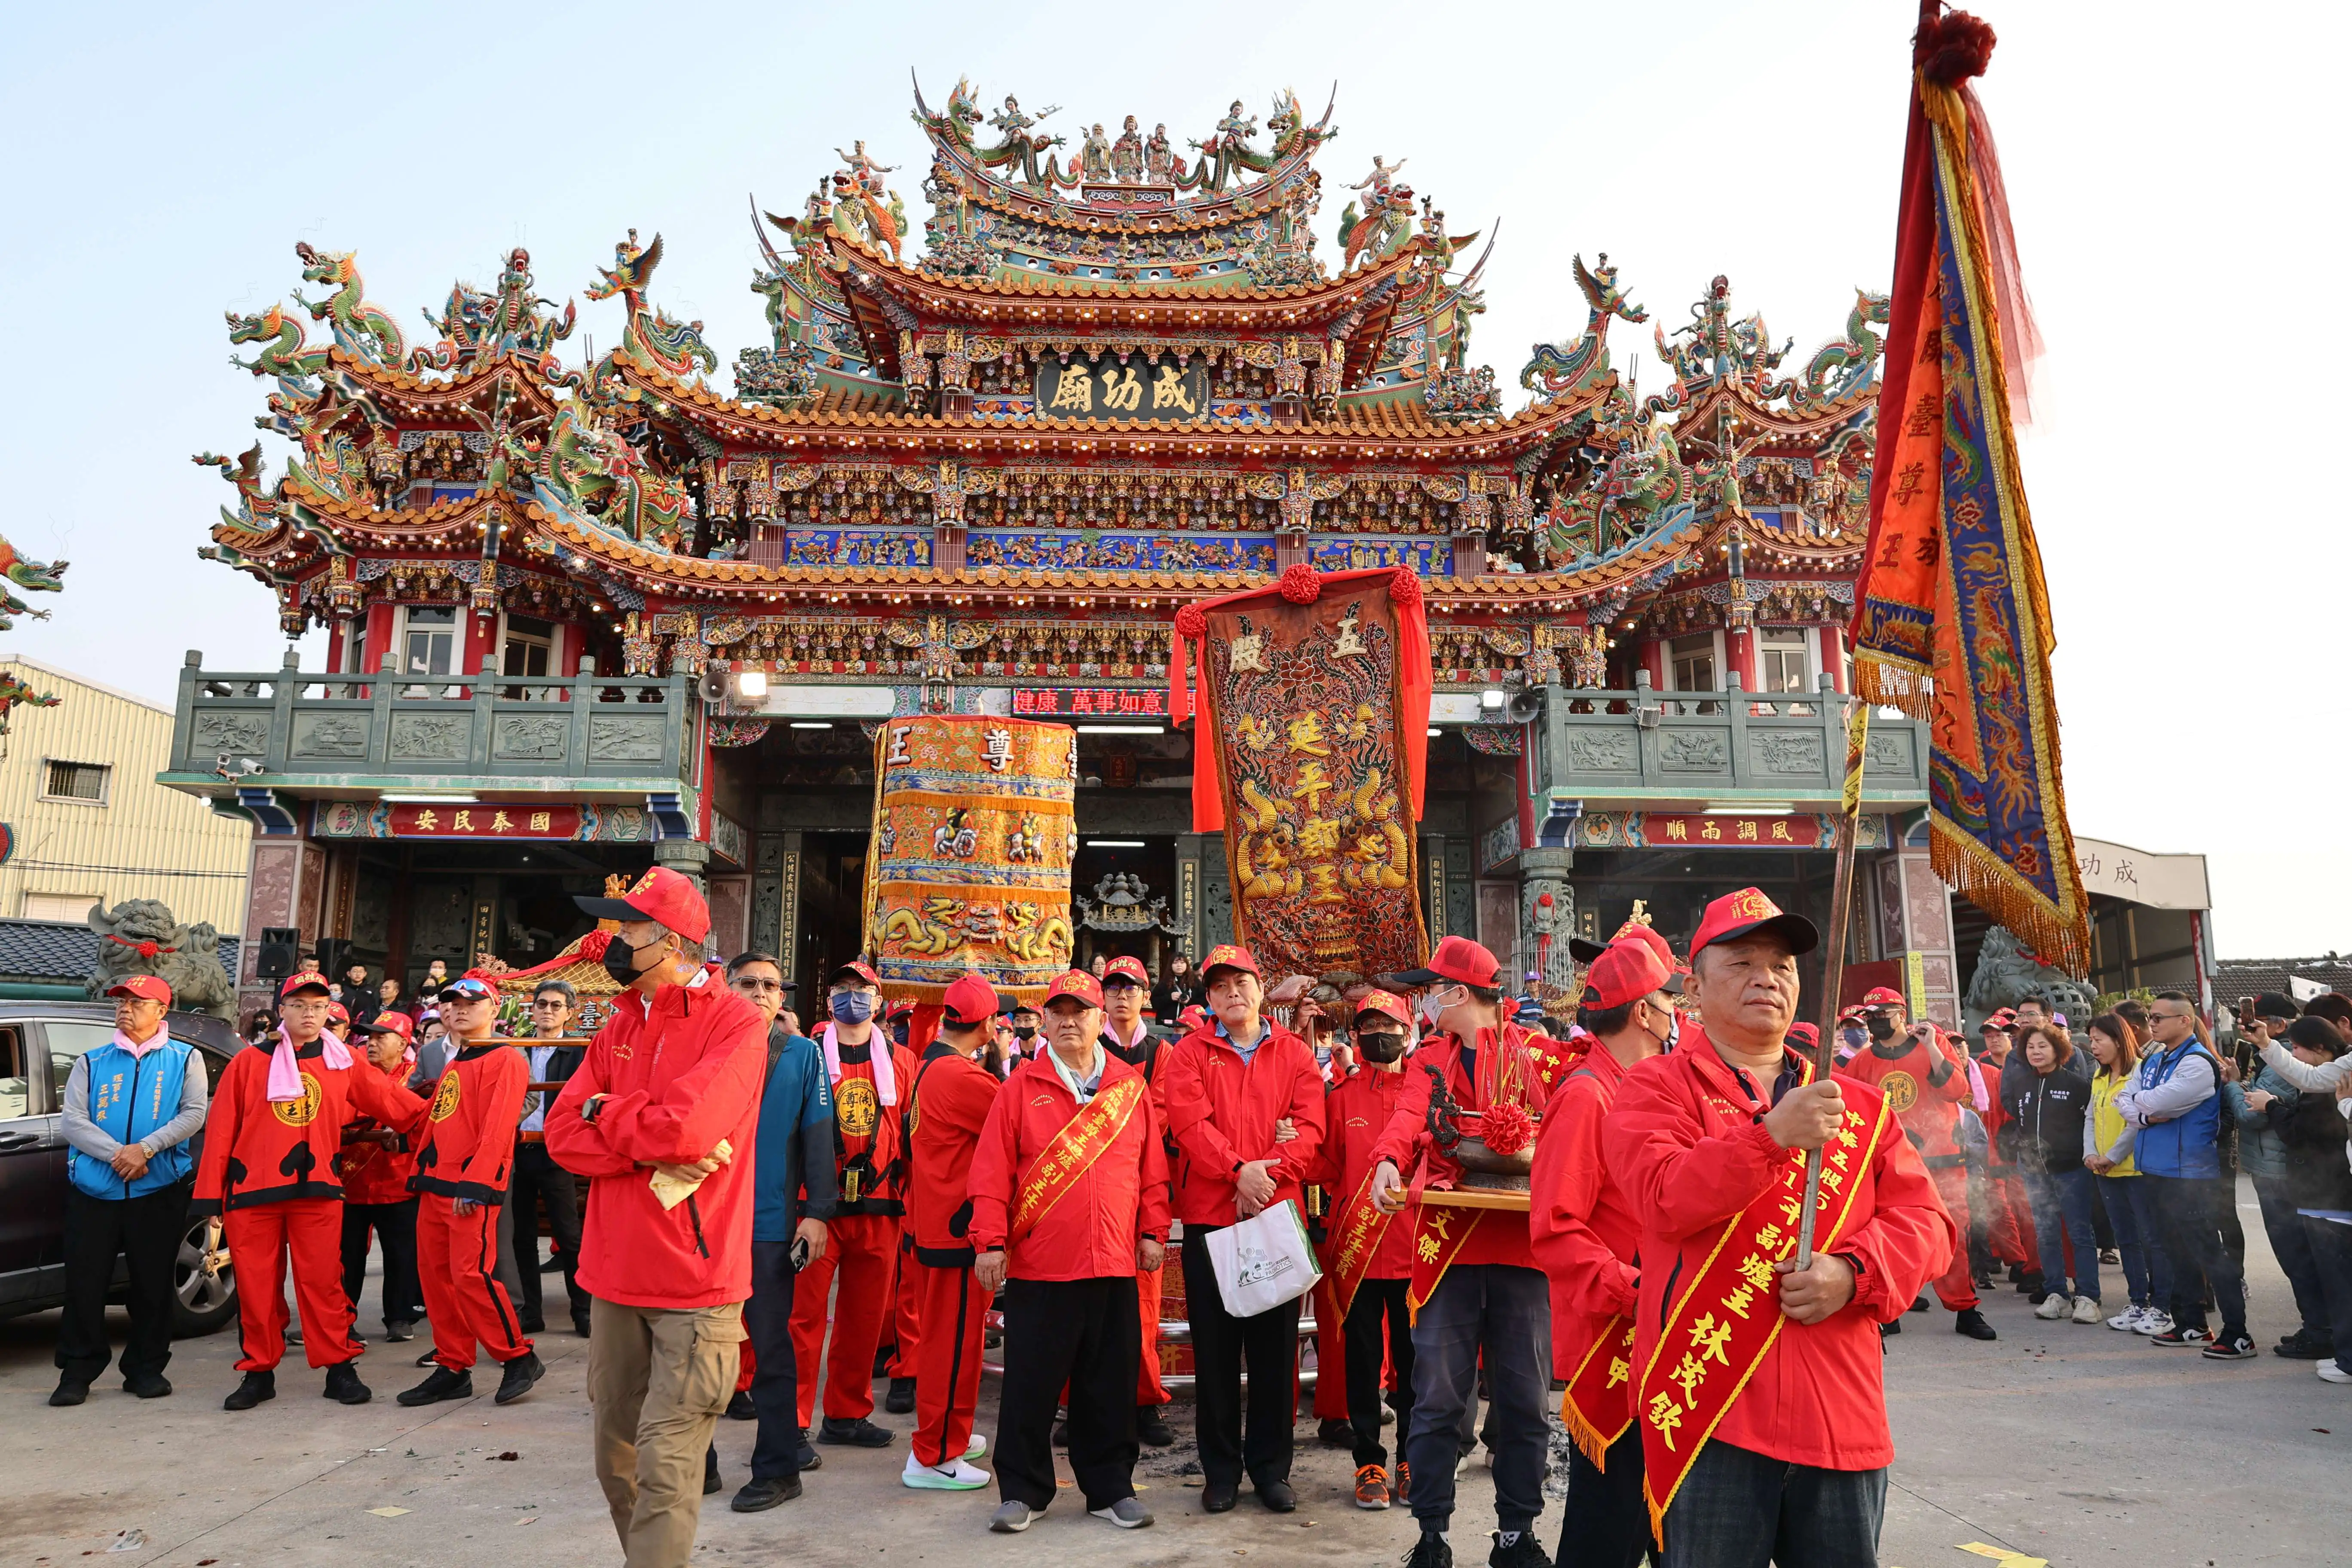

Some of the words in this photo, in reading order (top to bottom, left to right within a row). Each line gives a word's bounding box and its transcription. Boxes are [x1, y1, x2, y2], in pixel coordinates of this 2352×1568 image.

[1050, 364, 1195, 414] 成功廟
[1017, 689, 1058, 712] 健康
[1072, 690, 1163, 713] 萬事如意
[415, 809, 551, 832] 國泰民安
[1288, 710, 1348, 906] 延平郡王
[1666, 819, 1793, 842] 風調雨順
[2080, 853, 2138, 884] 成功
[578, 1001, 602, 1030] 臺
[111, 1073, 124, 1103] 理事長
[842, 1091, 859, 1124] 尊王
[1819, 1109, 1866, 1195] 中華五股
[1334, 1205, 1381, 1280] 副主任委員
[1418, 1209, 1455, 1265] 文傑
